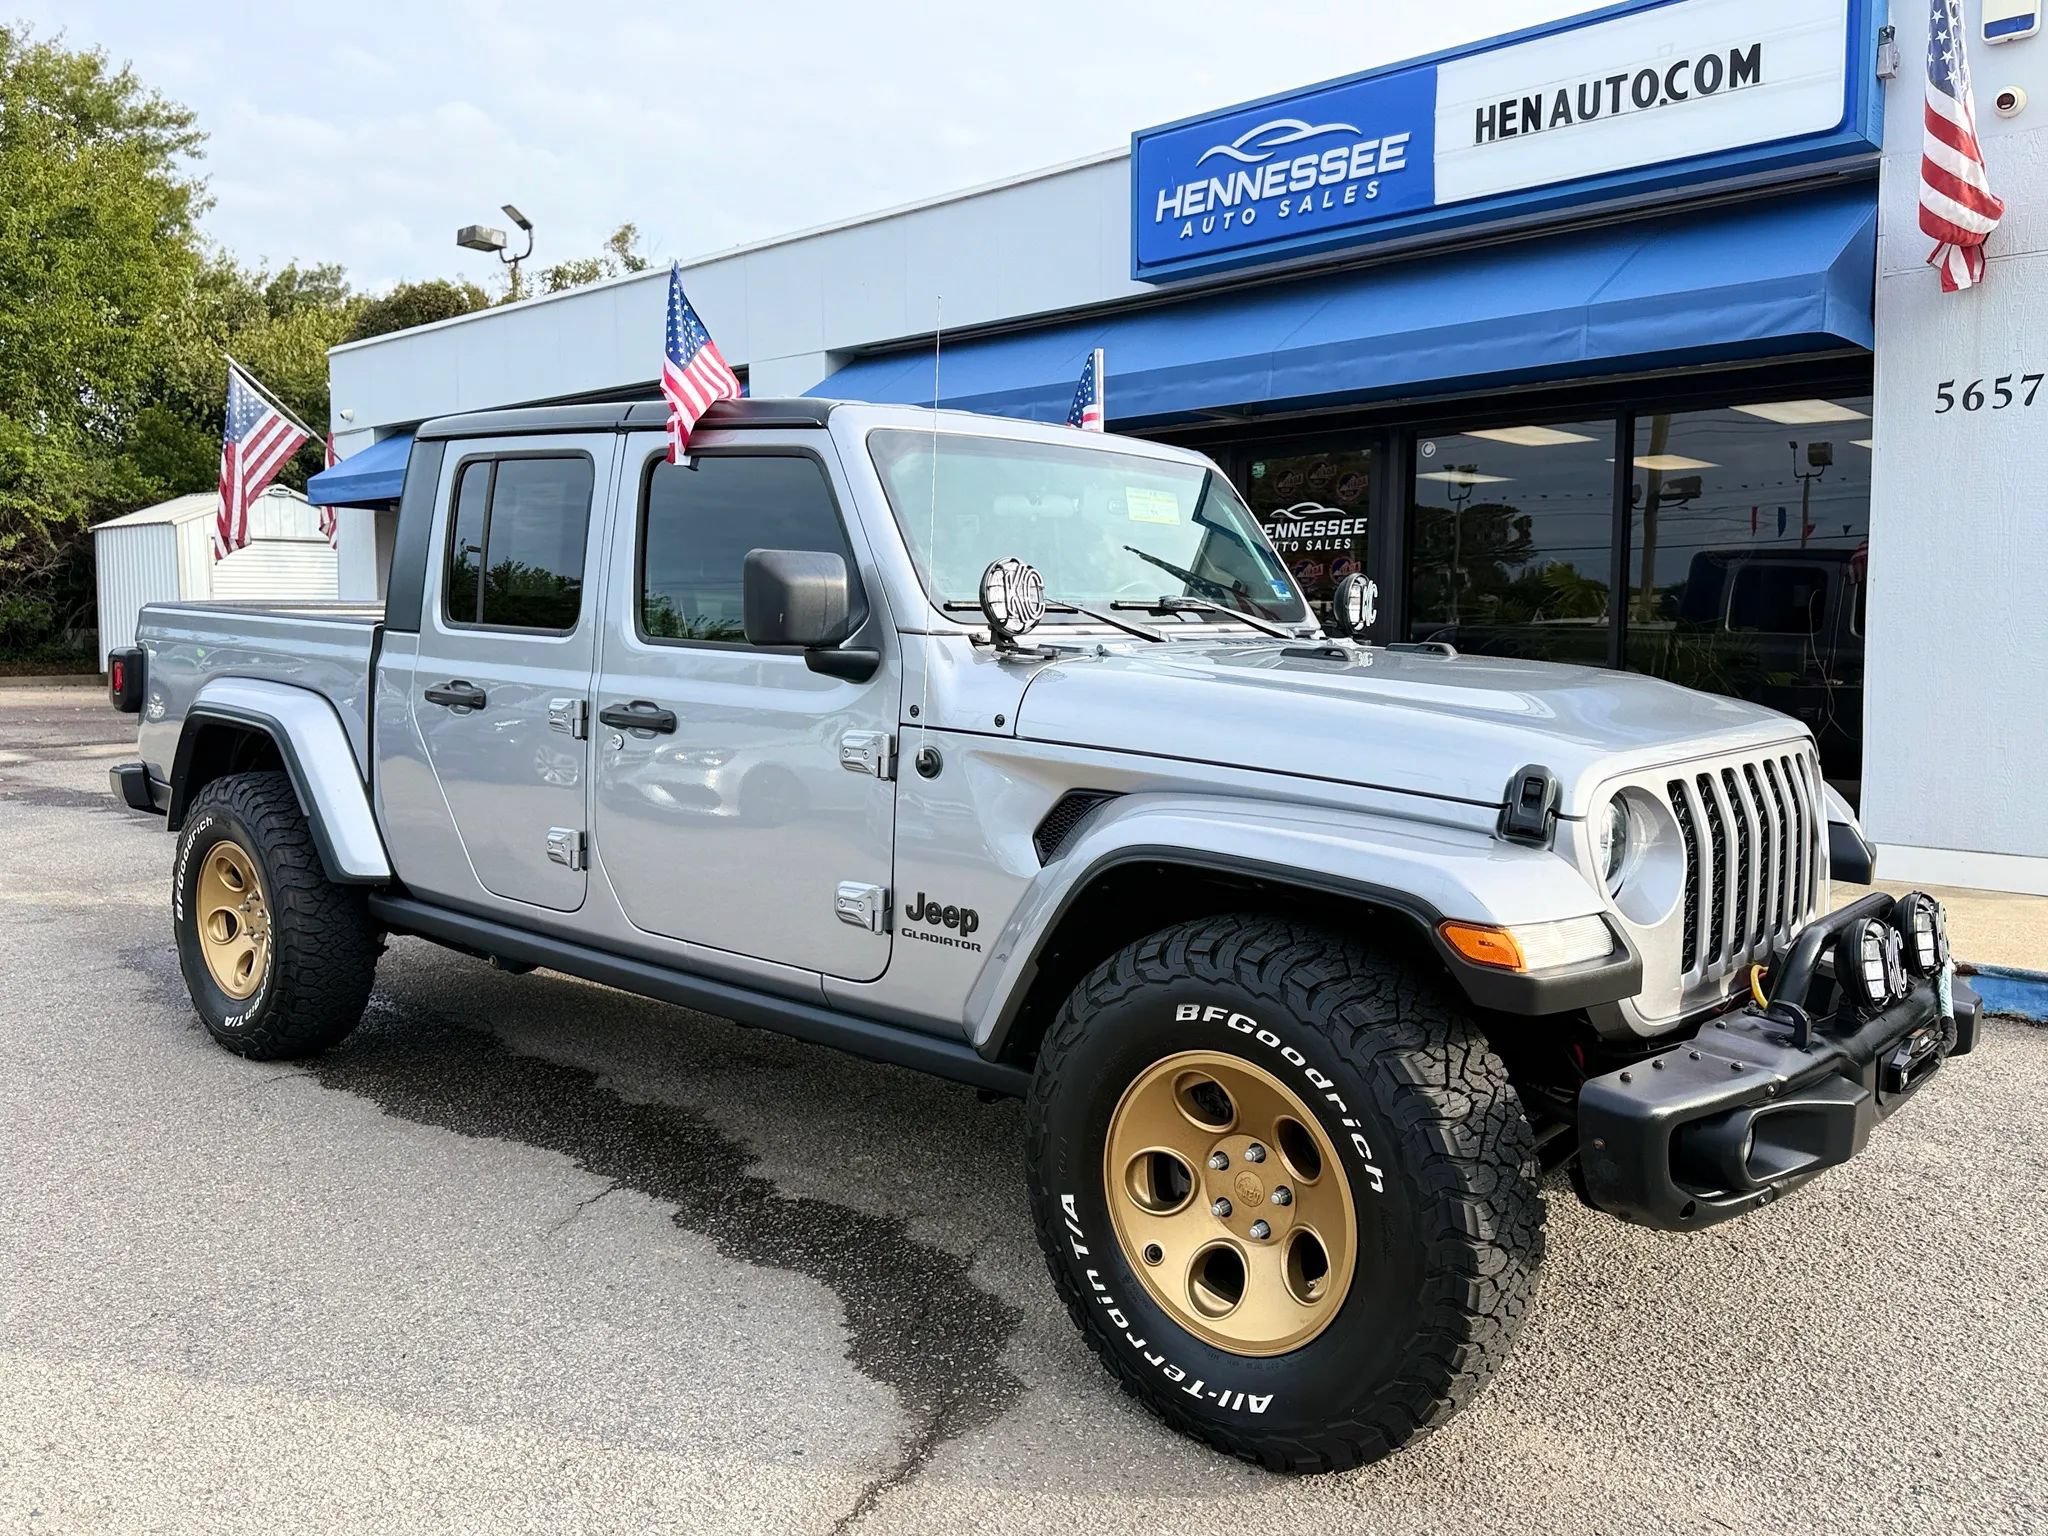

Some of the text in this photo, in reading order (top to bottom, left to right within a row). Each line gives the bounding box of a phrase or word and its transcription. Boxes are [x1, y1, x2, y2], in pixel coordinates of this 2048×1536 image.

[1155, 132, 1411, 222] HENNESSEE
[1179, 181, 1380, 238] AUTO SALES
[1934, 373, 2045, 414] 5657
[1262, 518, 1368, 539] ENNESSEE
[1273, 538, 1351, 552] UTO SALES
[177, 816, 213, 921] BFGoodrich
[901, 927, 981, 952] GLADIATOR
[905, 891, 979, 937] Jeep
[1175, 1003, 1384, 1194] BFGoodrich
[1060, 1194, 1090, 1260] T/A
[1085, 1268, 1275, 1414] All-Terrain
